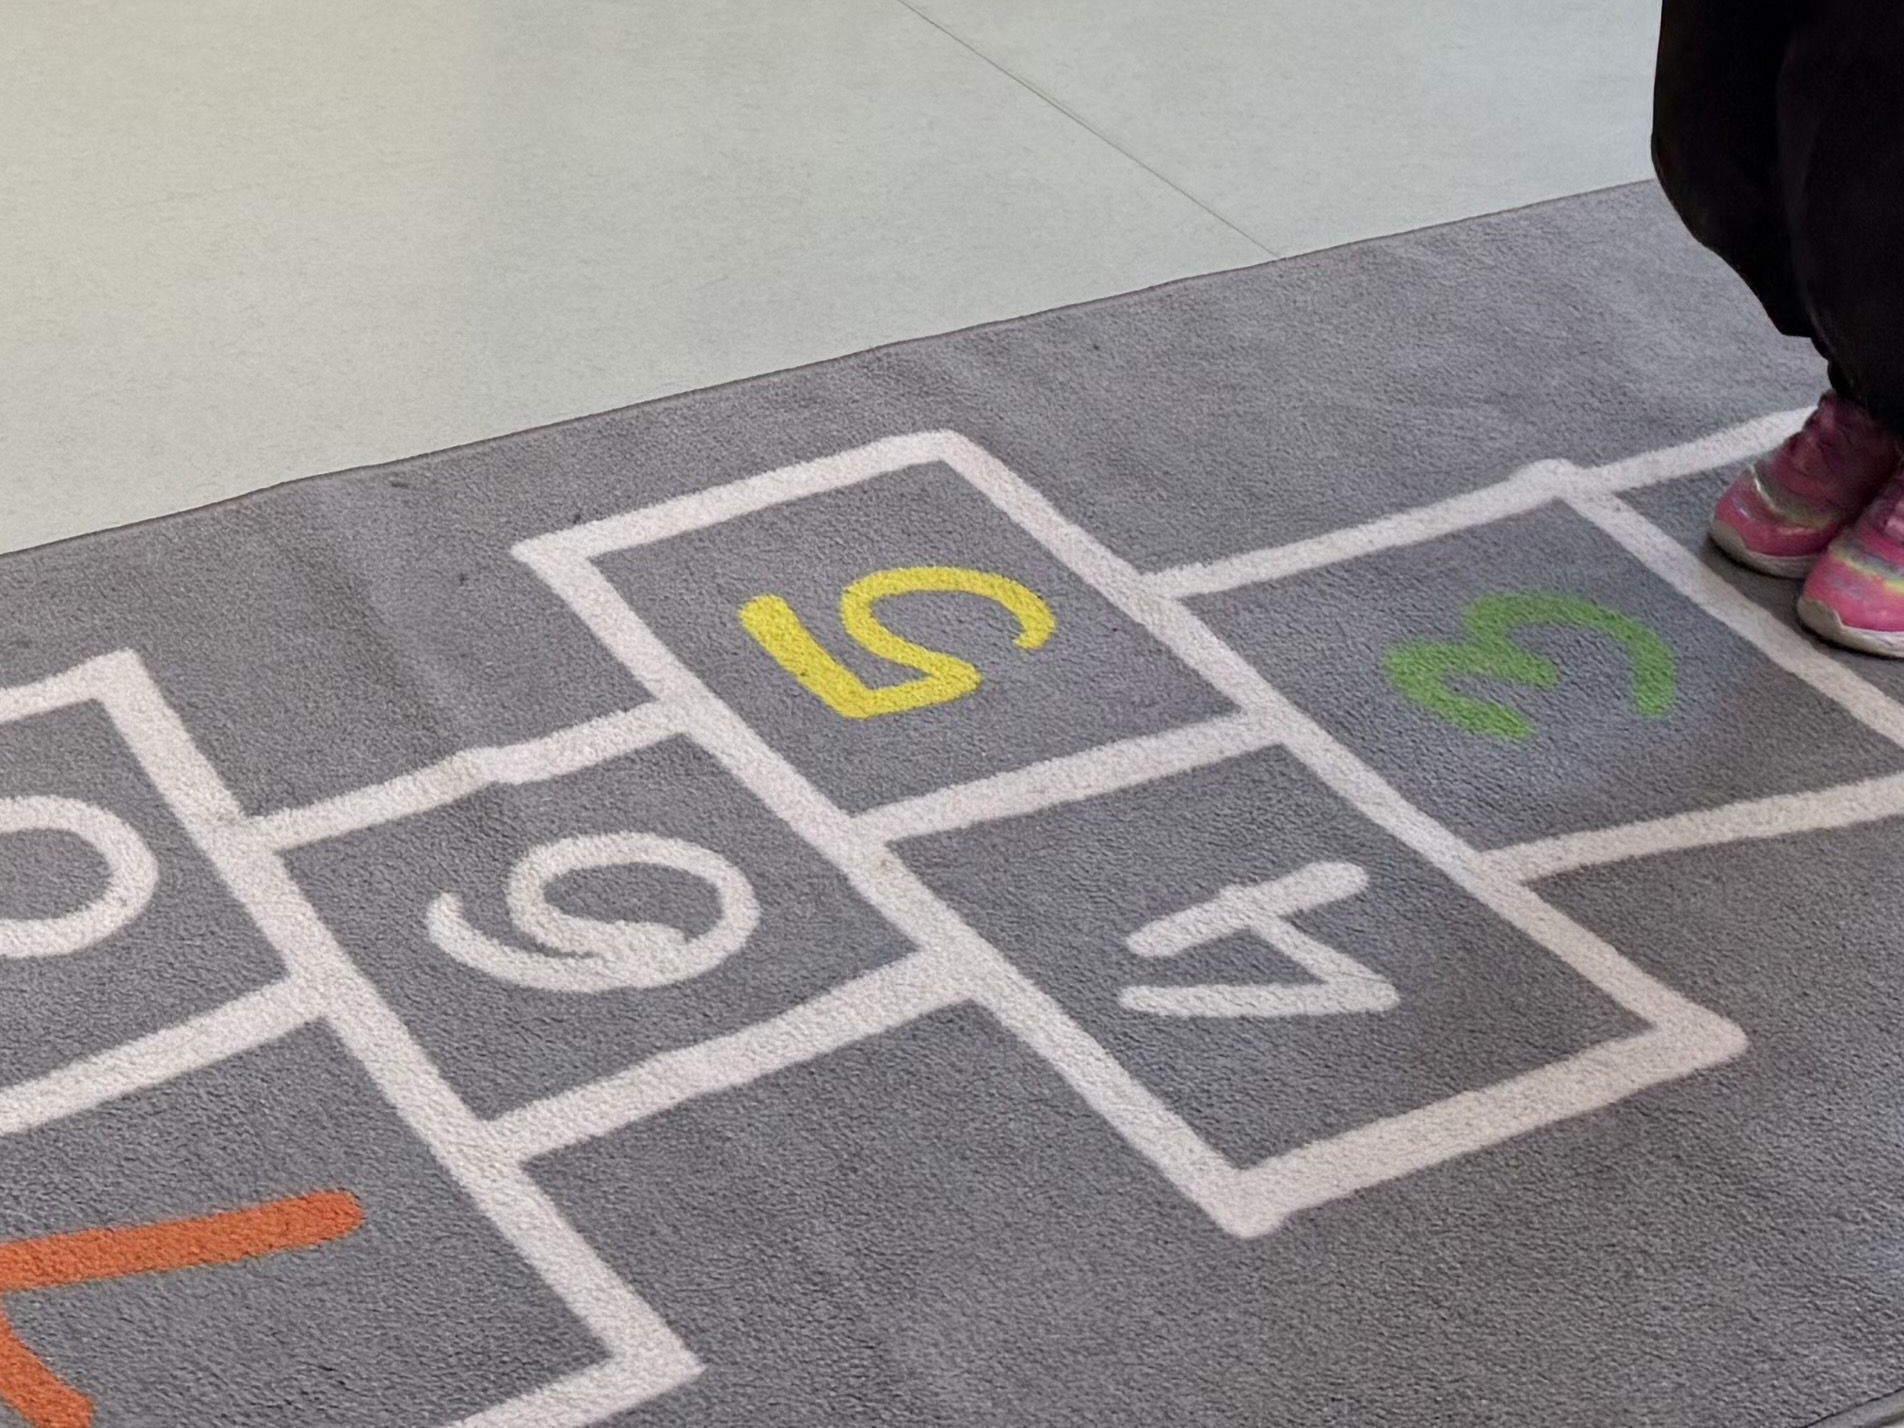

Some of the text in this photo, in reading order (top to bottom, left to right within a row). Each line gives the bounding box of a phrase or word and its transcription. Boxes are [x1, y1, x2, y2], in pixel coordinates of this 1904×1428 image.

[739, 566, 1053, 720] 5
[1385, 590, 1679, 740] 3
[424, 830, 761, 995] 6
[1120, 860, 1399, 1018] 4
